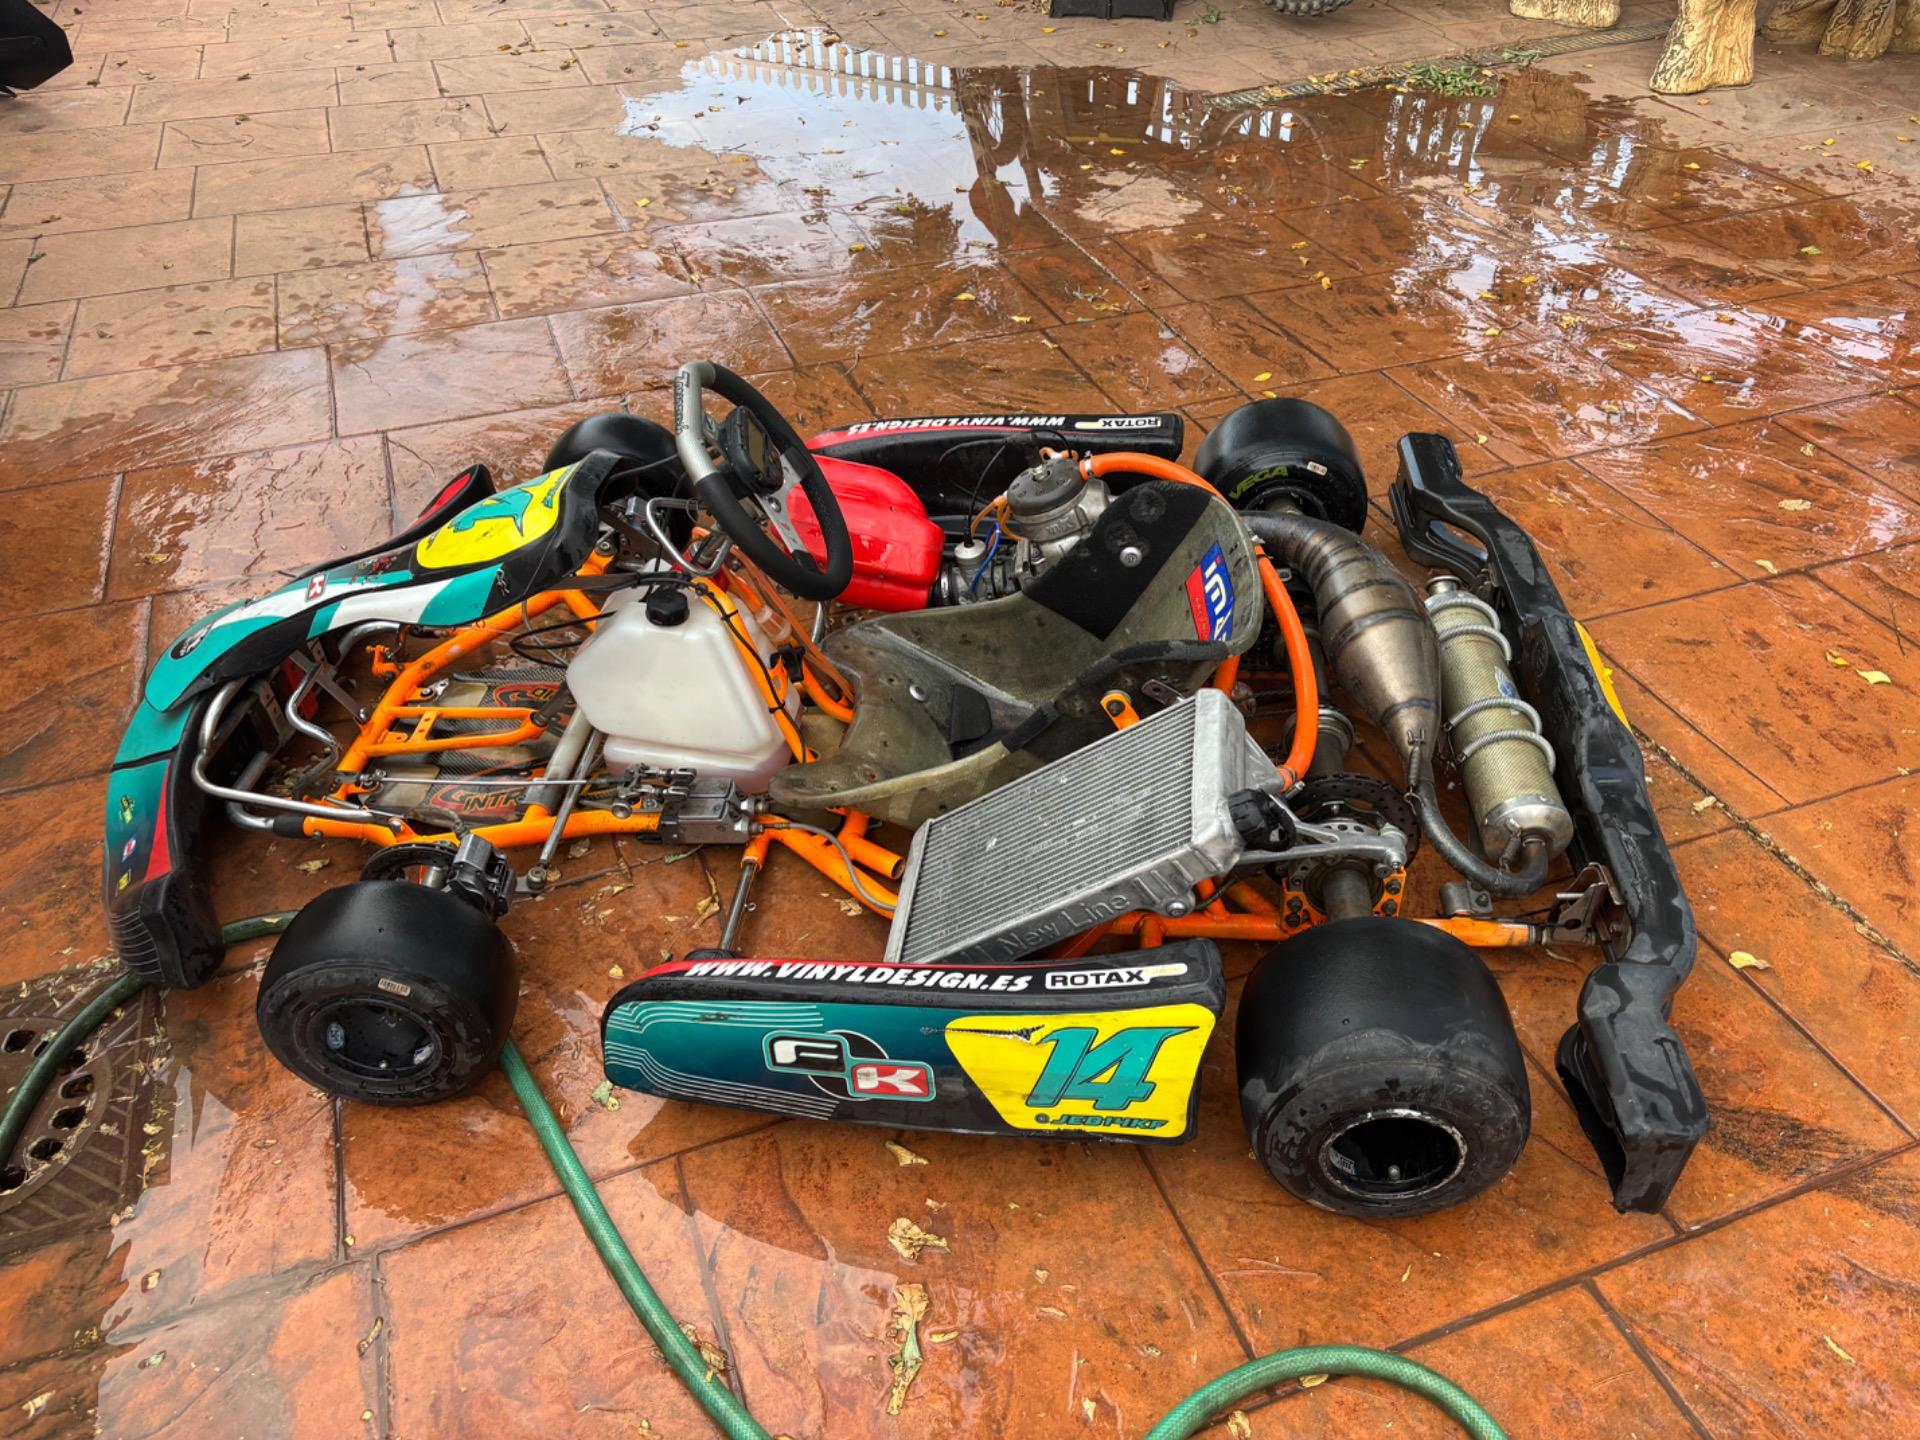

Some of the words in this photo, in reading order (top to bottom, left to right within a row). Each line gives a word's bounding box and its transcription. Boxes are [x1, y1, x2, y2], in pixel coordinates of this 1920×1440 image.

[848, 416, 1066, 435] WWW.VINYLDESIGN.ES
[1102, 418, 1159, 428] ROTAX
[1228, 465, 1289, 499] VEGA
[1061, 894, 1132, 931] Line
[685, 961, 1033, 992] WWW.VINYLDESIGN.ES
[1050, 969, 1146, 987] ROTAX
[1025, 1026, 1200, 1110] 14
